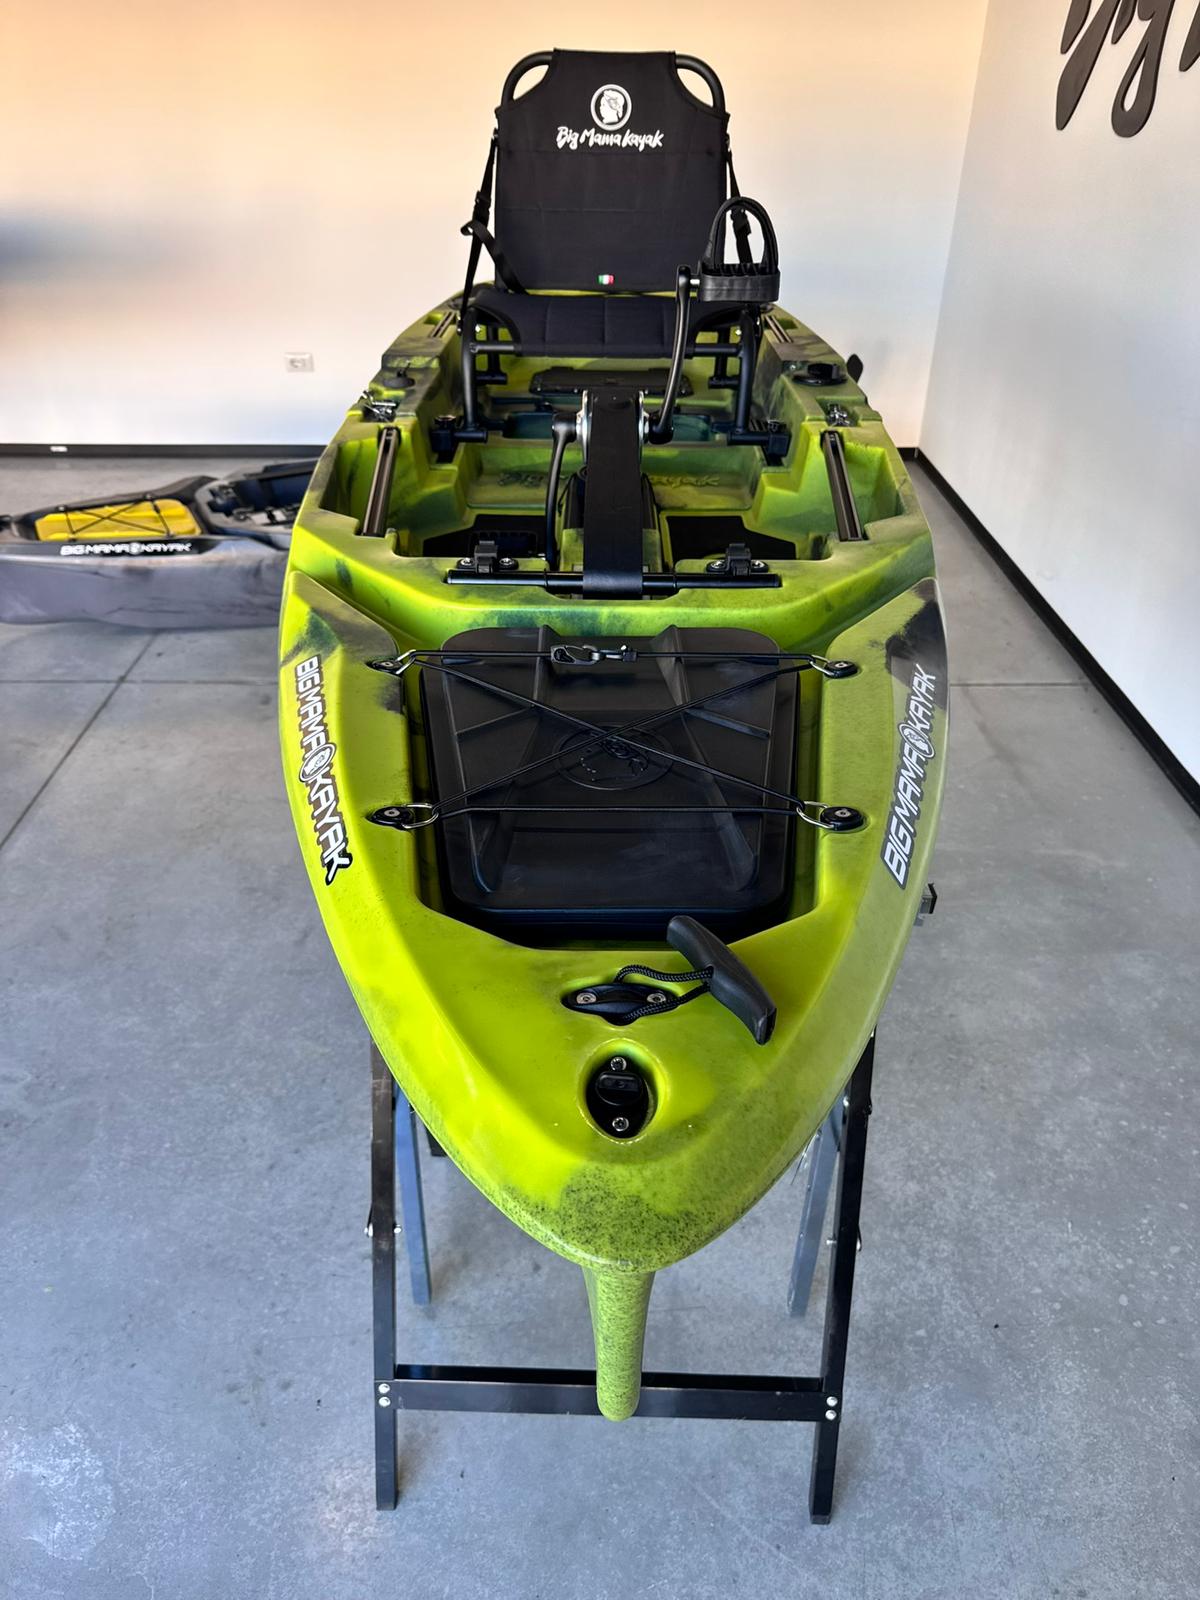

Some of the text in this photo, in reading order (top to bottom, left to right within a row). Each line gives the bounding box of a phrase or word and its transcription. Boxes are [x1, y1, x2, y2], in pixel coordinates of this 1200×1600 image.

[556, 126, 579, 150] Big
[580, 128, 622, 147] Mama
[907, 664, 936, 740] KAYAK
[308, 766, 351, 883] KAYAK
